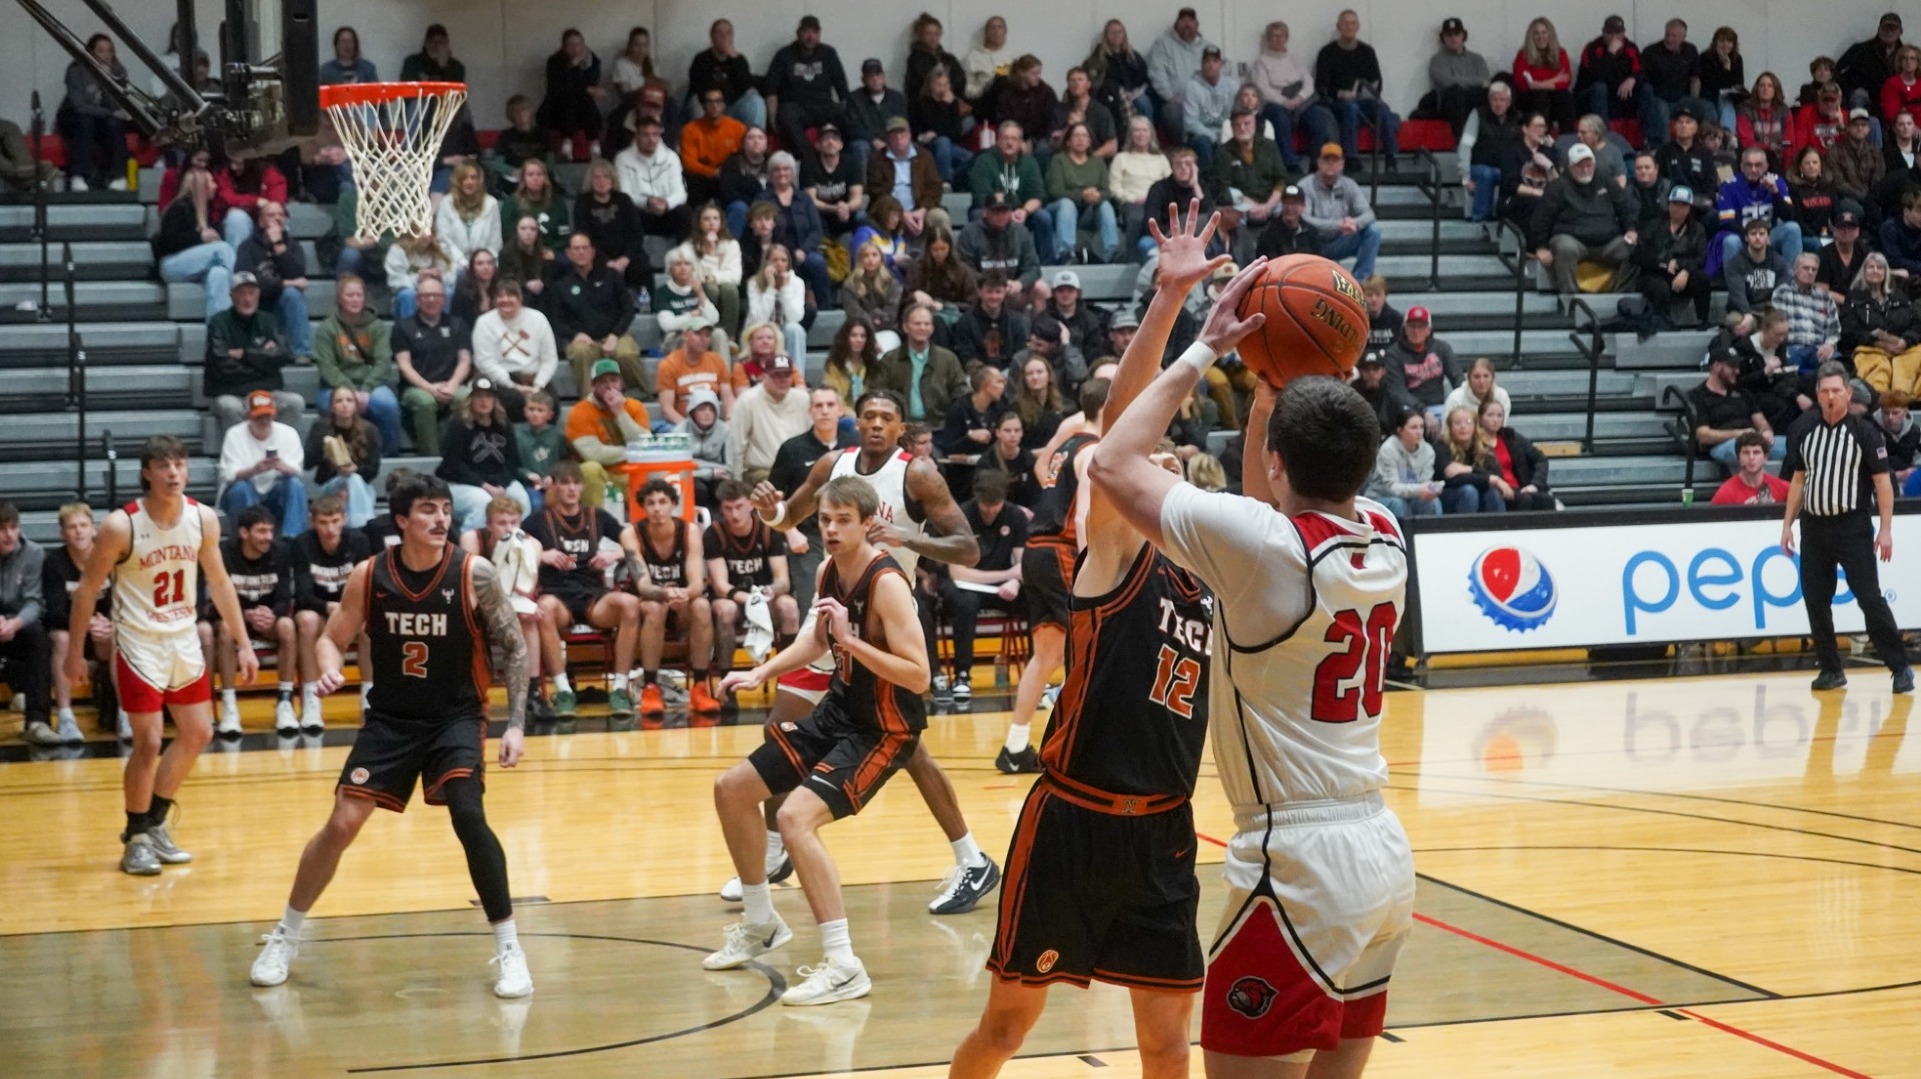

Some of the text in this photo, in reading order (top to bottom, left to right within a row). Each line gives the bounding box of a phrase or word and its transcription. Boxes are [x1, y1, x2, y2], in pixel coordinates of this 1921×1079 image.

[154, 569, 184, 608] 21
[1623, 545, 1858, 636] pep
[384, 611, 447, 636] TECH
[402, 641, 429, 678] 2
[1149, 643, 1201, 720] 12
[1311, 601, 1397, 723] 20
